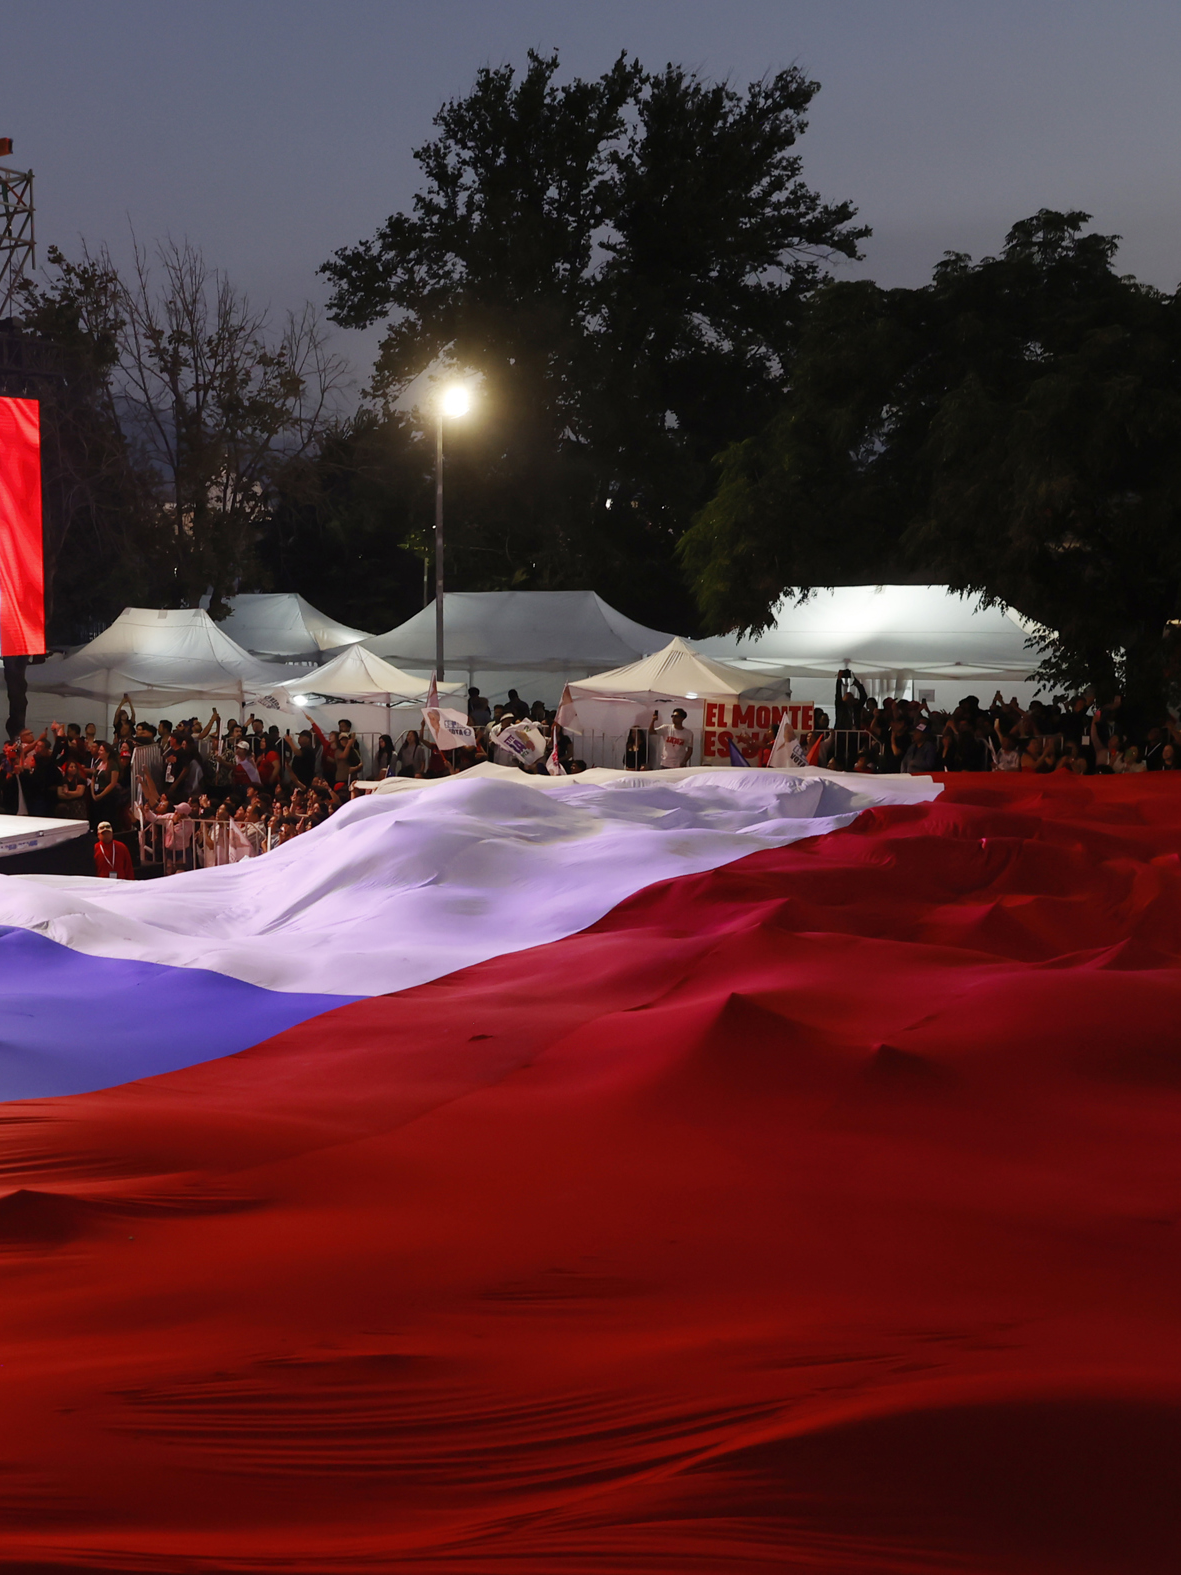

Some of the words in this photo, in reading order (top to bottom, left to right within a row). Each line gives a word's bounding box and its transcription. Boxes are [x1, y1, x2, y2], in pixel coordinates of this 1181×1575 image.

[705, 703, 727, 728] EL
[732, 704, 813, 730] MONTE
[704, 731, 733, 757] ES
